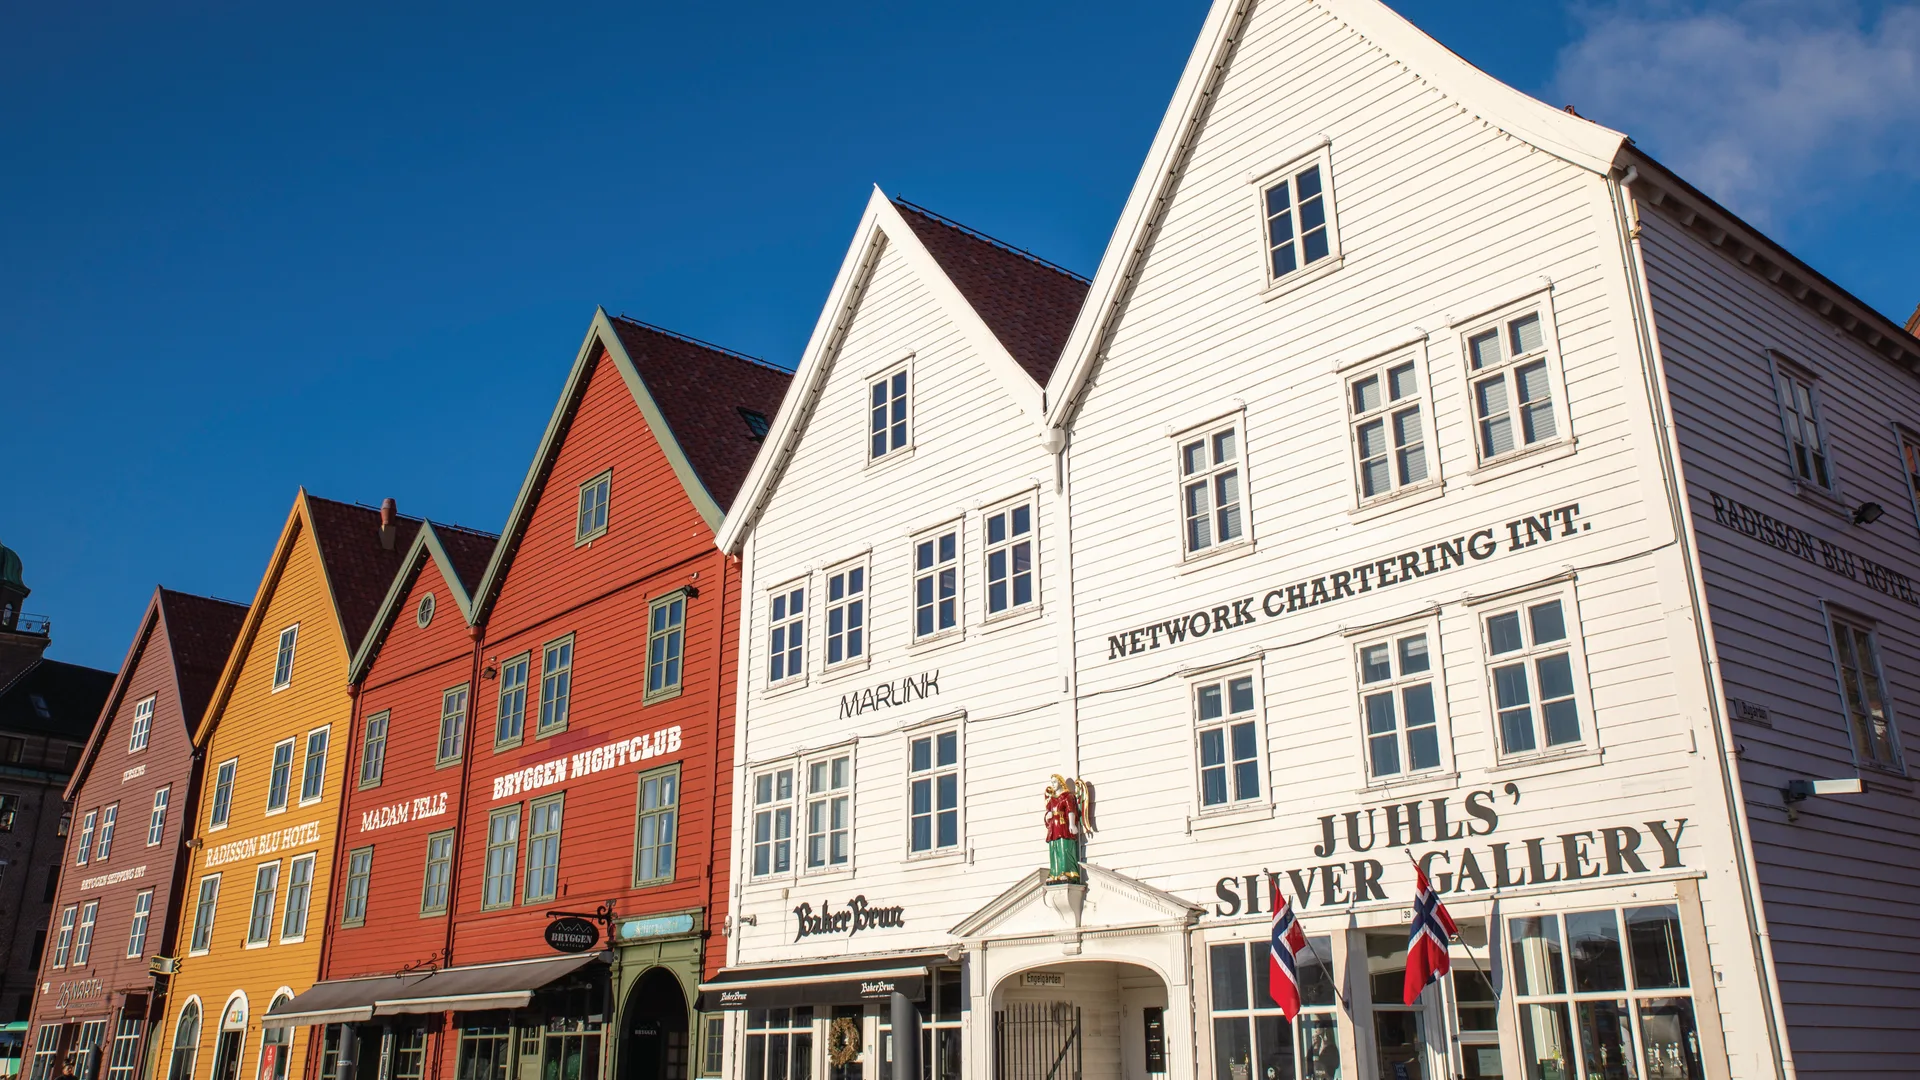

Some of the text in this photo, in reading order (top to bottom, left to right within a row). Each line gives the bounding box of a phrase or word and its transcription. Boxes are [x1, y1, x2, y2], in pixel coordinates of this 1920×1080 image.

[1710, 491, 1919, 605] RADISSON BLU HOTEL
[1108, 503, 1591, 661] NETWORK CHARTERING INT.
[840, 669, 939, 720] MARLINK
[492, 725, 682, 800] BRYGGEN NIGHTCLUB
[360, 792, 448, 832] MADAM FELLE
[1314, 782, 1520, 858] JUHLS'
[205, 821, 320, 867] RADISSON BLU HOTEL
[1418, 819, 1688, 895] GALLERY
[551, 932, 592, 944] BRYGGEN
[1403, 910, 1411, 919] 39
[1027, 973, 1062, 985] Engelgården
